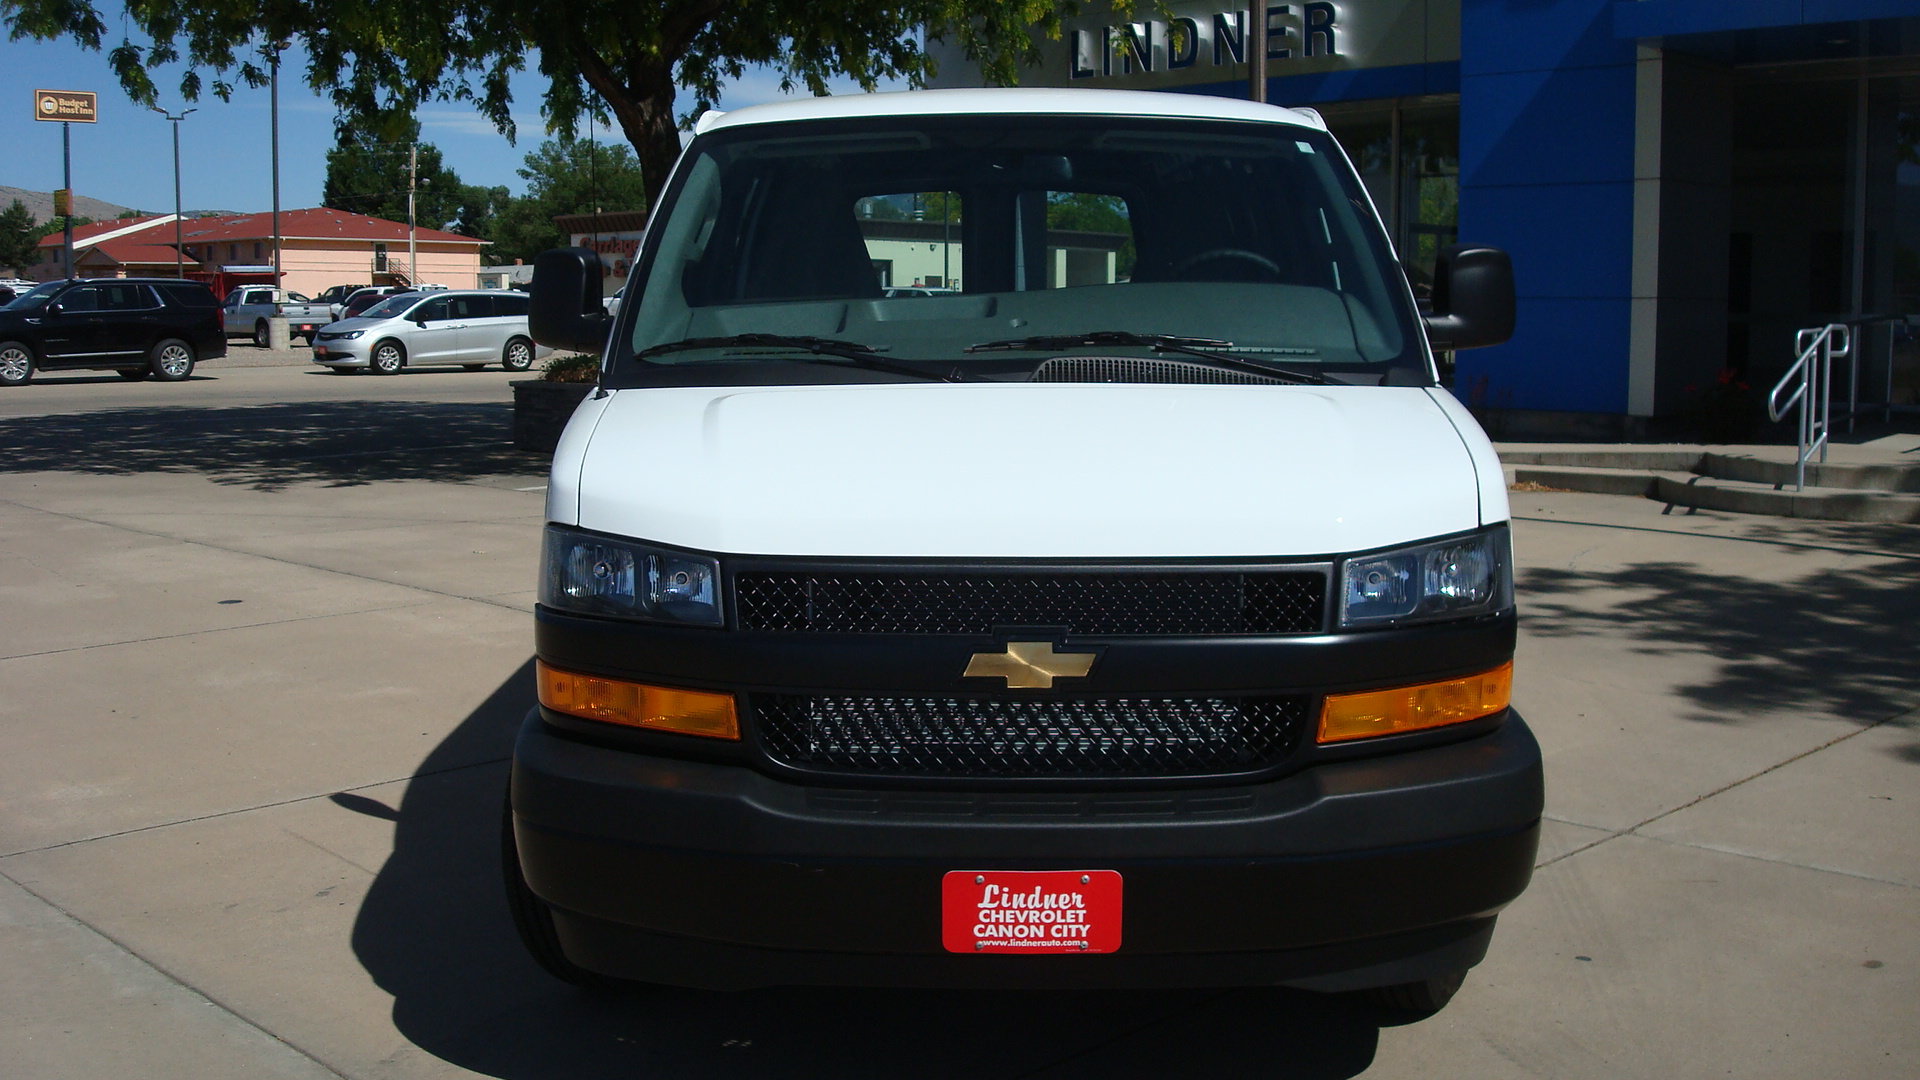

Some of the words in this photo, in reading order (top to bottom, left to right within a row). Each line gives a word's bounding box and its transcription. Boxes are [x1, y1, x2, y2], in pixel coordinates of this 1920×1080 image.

[1070, 1, 1336, 80] LINDNER
[59, 98, 88, 108] Budget
[59, 106, 79, 114] Host
[977, 884, 1086, 910] Lindner
[978, 910, 1087, 924] CHEVROLET
[973, 924, 1045, 938] CANON
[1050, 924, 1091, 938] CITY
[982, 938, 1081, 948] www.lindnerauto.com
